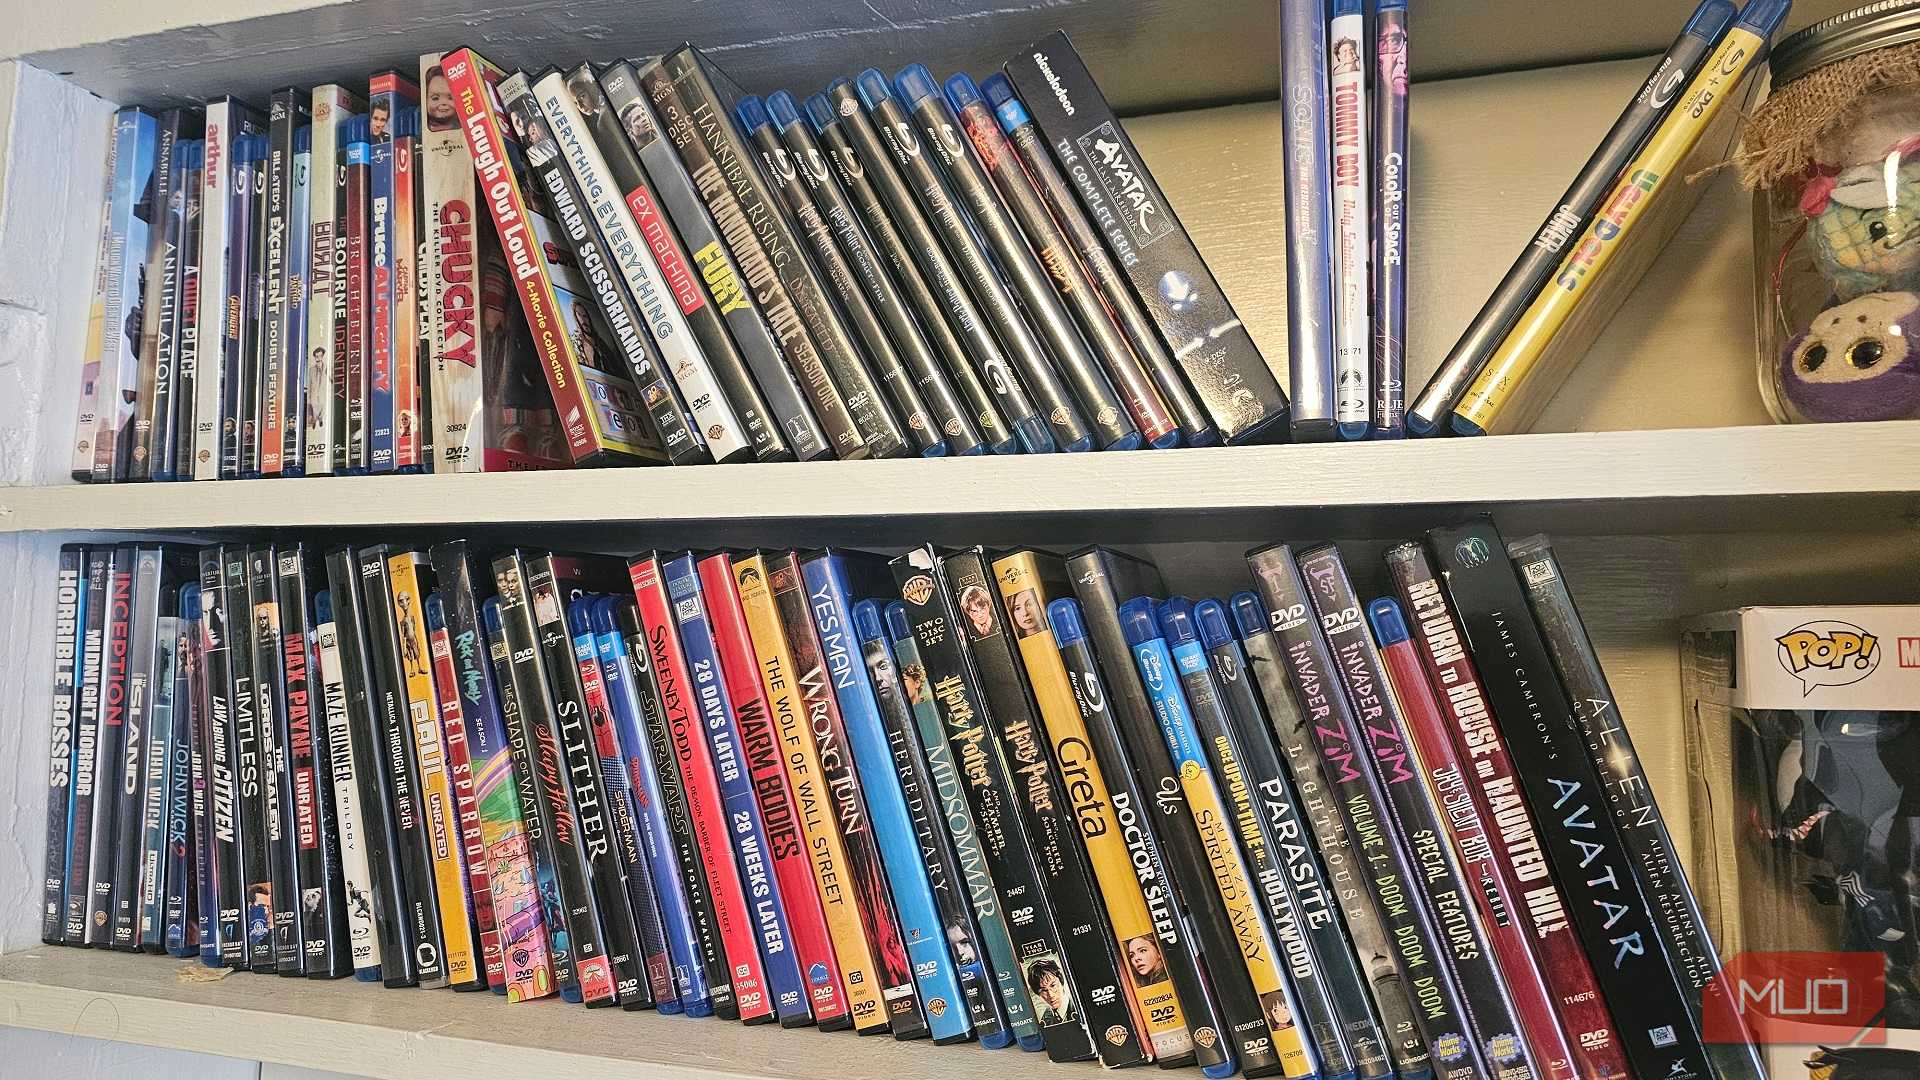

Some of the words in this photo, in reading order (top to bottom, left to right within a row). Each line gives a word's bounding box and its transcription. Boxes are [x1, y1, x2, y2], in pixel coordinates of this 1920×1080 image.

[447, 63, 467, 80] DVD
[460, 87, 475, 115] The
[653, 85, 676, 104] MGM
[1033, 52, 1075, 117] nickelodeon
[667, 105, 679, 120] 3
[668, 113, 695, 138] DISC
[676, 131, 699, 149] SET
[1335, 81, 1359, 148] TOMMY
[156, 128, 173, 197] ANNABELLE
[206, 122, 224, 189] arthur
[466, 111, 505, 183] Laugh
[1336, 152, 1359, 188] BOY
[430, 201, 440, 223] THE
[491, 181, 517, 223] Out
[632, 194, 653, 220] ex
[692, 101, 753, 205] HANNIBAL
[747, 201, 793, 269] RISING
[1057, 138, 1078, 164] THE
[1071, 165, 1113, 228] COMPLETE
[1108, 227, 1140, 267] SERIES
[1094, 137, 1155, 236] AVATAR
[373, 196, 391, 268] Bruce
[431, 225, 442, 268] KILLER
[503, 218, 541, 281] Loud
[1532, 203, 1584, 255] JOKER
[1555, 168, 1661, 294] UGLYDOLLS
[265, 215, 288, 315] EXCELLENT
[334, 237, 348, 320] BOURNE
[433, 272, 442, 296] DVD
[437, 199, 477, 370] CHUCKY
[543, 166, 587, 242] EDWARD
[578, 241, 651, 377] SCISSORHANDS
[596, 200, 674, 341] EVERYTHING
[693, 239, 752, 316] FURY
[155, 241, 178, 395] ANNIHILATION
[347, 232, 361, 376] BRIGHTBURN
[372, 265, 392, 394] ALMIGHTY
[525, 279, 548, 330] 4-Movie
[707, 190, 788, 306] HANDMAID'S
[766, 301, 808, 347] TALE
[792, 341, 824, 390] SEASON
[815, 384, 835, 413] ONE
[266, 319, 280, 371] DOUBLE
[333, 322, 348, 400] IDENTITY
[541, 329, 567, 390] Collection
[264, 373, 279, 431] FEATURE
[445, 423, 467, 434] 30924
[54, 569, 79, 688] HORRIBLE
[104, 572, 131, 727] INCEPTION
[811, 583, 838, 637] YES
[832, 634, 858, 689] MAN
[915, 615, 945, 634] TWO
[919, 624, 946, 642] DISC
[924, 635, 944, 648] SET
[1407, 577, 1466, 667] RETURN
[1775, 629, 1879, 673] POP!
[81, 629, 102, 721] MIDNIGHT
[325, 682, 347, 723] MAZE
[648, 623, 681, 710] SWEENEY
[671, 704, 692, 764] TODD
[694, 657, 715, 685] 28
[764, 656, 786, 692] THE
[1490, 610, 1518, 659] JAMES
[1514, 665, 1559, 761] CAMERON'S
[49, 694, 73, 788] BOSSES
[125, 677, 143, 796] ISLAND
[235, 677, 259, 799] LIMITLESS
[288, 690, 312, 761] PAYNE
[385, 691, 396, 725] METALLICA
[442, 701, 465, 745] RED
[474, 717, 487, 746] SEASON
[503, 700, 523, 761] SHAPE
[701, 685, 728, 731] DAYS
[737, 697, 779, 773] WARM
[774, 694, 802, 747] WOLF
[1155, 700, 1170, 732] STUDIO
[1445, 679, 1503, 759] HOUSE
[76, 723, 98, 797] HORROR
[151, 738, 165, 781] JOHN
[174, 739, 190, 790] JOHN
[191, 751, 202, 781] JOHN
[275, 746, 285, 774] THE
[330, 724, 353, 783] RUNNER
[388, 726, 405, 776] THROUGH
[409, 698, 446, 791] PAUL
[518, 761, 529, 775] OF
[641, 690, 670, 764] STAR
[662, 762, 689, 836] WARS
[713, 732, 741, 784] LATER
[789, 750, 809, 777] OF
[799, 665, 841, 773] WRONG
[828, 765, 863, 838] TURN
[1475, 759, 1496, 780] ON
[1573, 700, 1633, 833] QUADRILOGY
[1586, 698, 1658, 828] ALIEN
[193, 789, 204, 818] WICK
[213, 763, 235, 843] CITIZEN
[266, 768, 280, 841] SALEM
[295, 770, 313, 845] UNRATED
[395, 776, 408, 796] THE
[399, 796, 414, 831] NEVER
[517, 777, 542, 840] WATER
[556, 700, 609, 864] SLITHER
[798, 780, 823, 833] WALL
[889, 728, 949, 892] HEREDITARY
[1056, 736, 1108, 841] Greta
[343, 787, 354, 850] TRILOGY
[431, 796, 449, 857] UNRATED
[451, 762, 488, 875] SPARROW
[733, 810, 753, 834] 28
[756, 772, 802, 862] BODIES
[925, 742, 996, 922] MIDSOMMAR
[1286, 744, 1364, 922] LIGHTHOUSE
[1482, 775, 1550, 883] HAUNTED
[690, 785, 702, 817] DEMON
[698, 819, 713, 857] BARBER
[718, 900, 733, 935] STREET
[740, 833, 772, 899] WEEKS
[812, 835, 845, 907] STREET
[1111, 790, 1156, 885] DOCTOR
[1142, 883, 1178, 945] SLEEP
[1142, 832, 1159, 870] STEPHEN
[1215, 735, 1233, 764] ONCE
[1258, 868, 1314, 980] HOLLYWOOD
[1258, 776, 1332, 931] PARASITE
[1546, 777, 1646, 971] AVATAR
[680, 842, 690, 863] THE
[687, 869, 701, 904] FORCE
[696, 910, 715, 963] AWAKENS
[1006, 886, 1026, 899] 24457
[1195, 809, 1237, 901] SPIRITED
[1228, 907, 1266, 964] AWAY
[1345, 793, 1385, 851] VOLUME
[1374, 873, 1410, 918] DOOM
[1394, 924, 1429, 969] DOOM
[1412, 975, 1449, 1021] DOOM
[1412, 828, 1450, 884] SPECIAL
[1434, 889, 1481, 962] FEATURES
[1523, 884, 1570, 939] HILL
[1649, 837, 1672, 875] ALIEN
[1670, 893, 1696, 937] ALIENS
[756, 899, 786, 956] LATER
[1072, 922, 1093, 938] 21331
[1641, 851, 1664, 890] ALIEN
[1656, 893, 1703, 989] RESURRECTION
[735, 980, 759, 993] 35006
[1563, 991, 1596, 1006] 114676
[1154, 1033, 1192, 1047] FOCUS
[1234, 1018, 1265, 1032] 61200733
